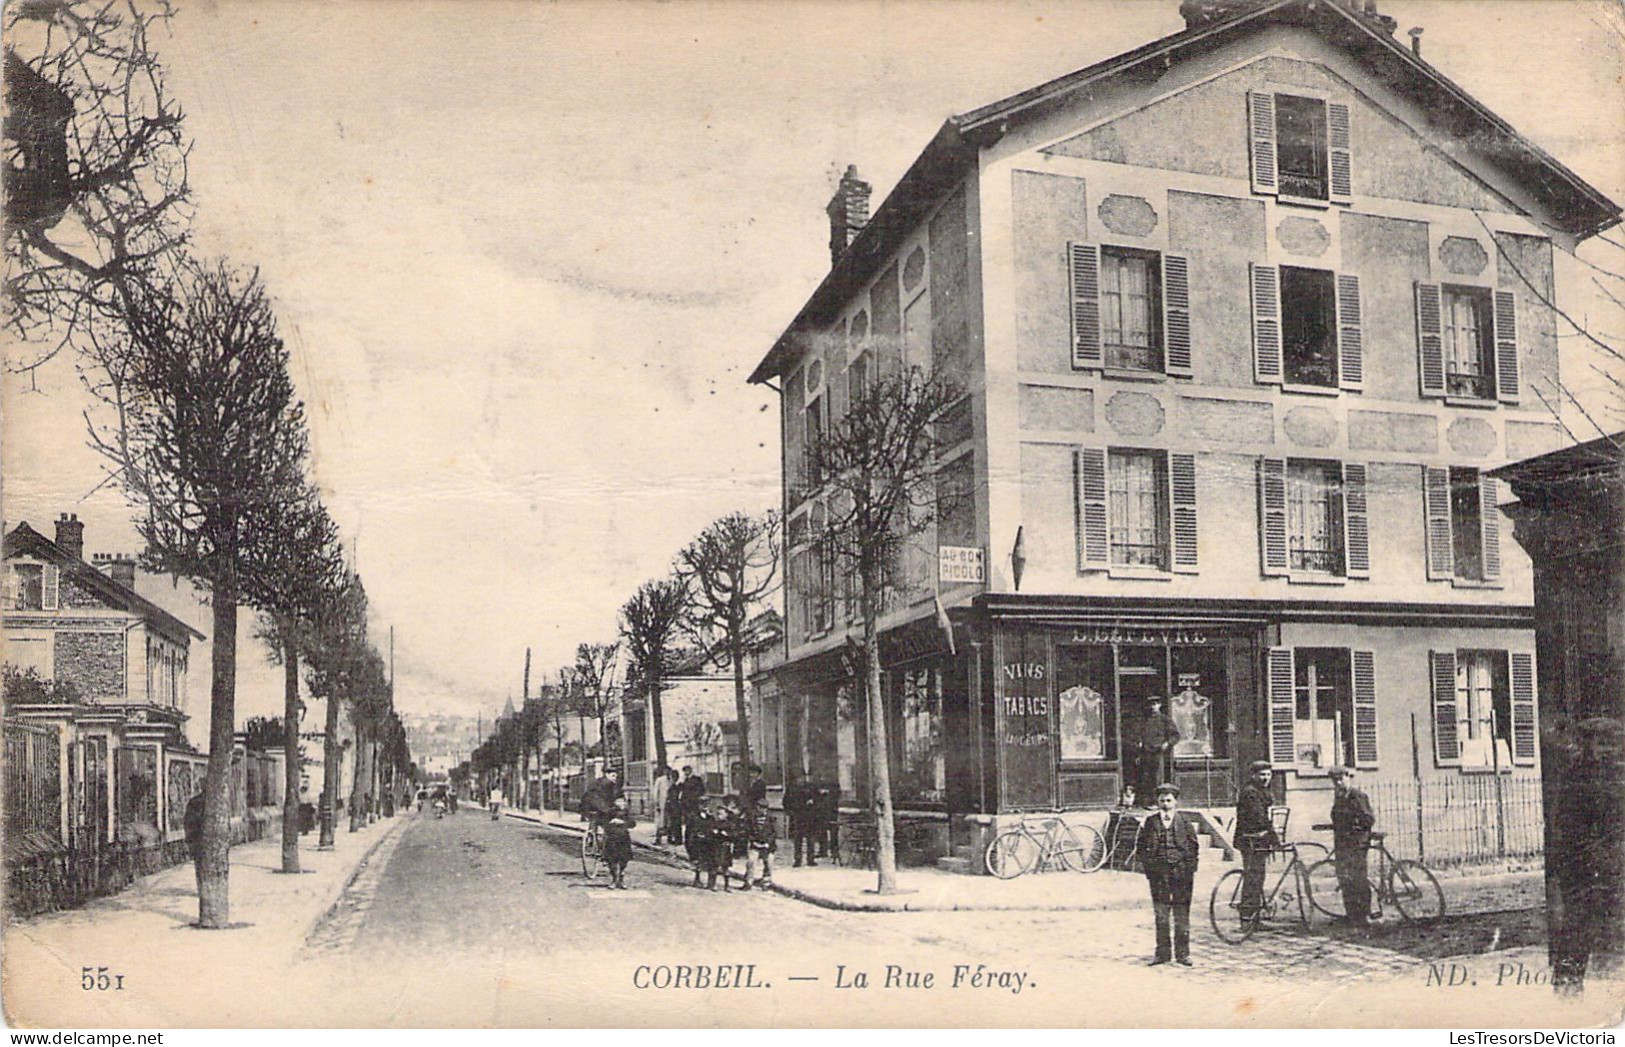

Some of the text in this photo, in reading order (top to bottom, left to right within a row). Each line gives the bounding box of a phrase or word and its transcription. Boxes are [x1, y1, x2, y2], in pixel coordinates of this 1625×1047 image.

[943, 549, 982, 562] AU BON
[1004, 663, 1045, 680] VINS
[1004, 697, 1048, 716] TABACS
